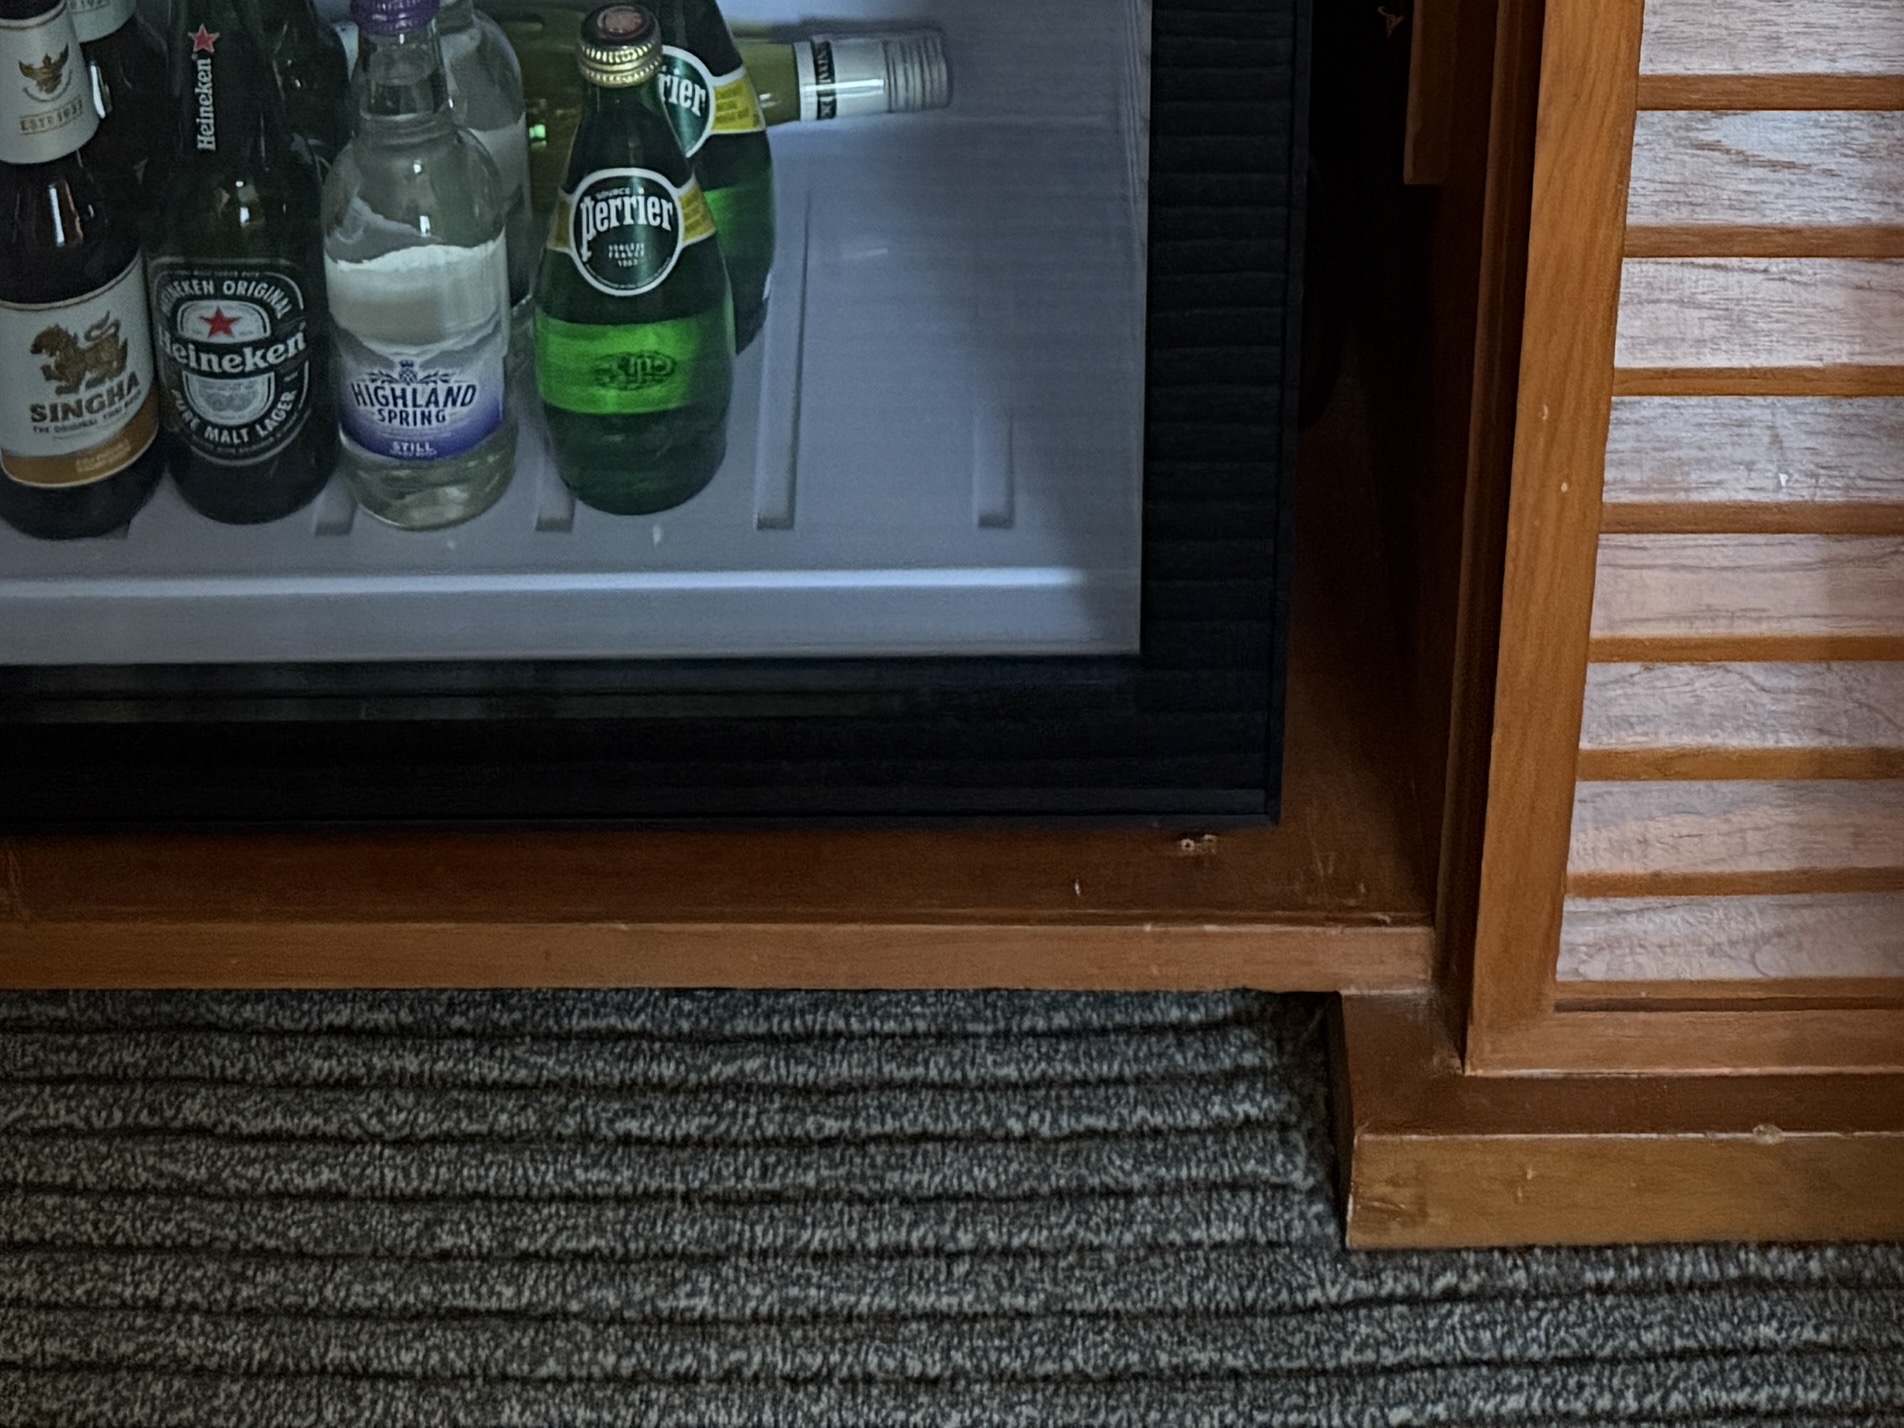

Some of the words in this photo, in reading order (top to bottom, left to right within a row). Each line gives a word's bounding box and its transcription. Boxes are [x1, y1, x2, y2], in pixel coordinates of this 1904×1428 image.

[194, 56, 217, 152] Heineken
[658, 68, 707, 118] rier
[222, 278, 293, 320] ORIGINAL
[157, 323, 307, 374] Heineken
[29, 370, 140, 424] SINGHA
[203, 425, 251, 445] MALT
[254, 390, 297, 438] LAGER
[350, 382, 477, 409] HIGHLAND
[376, 408, 447, 427] SPRING
